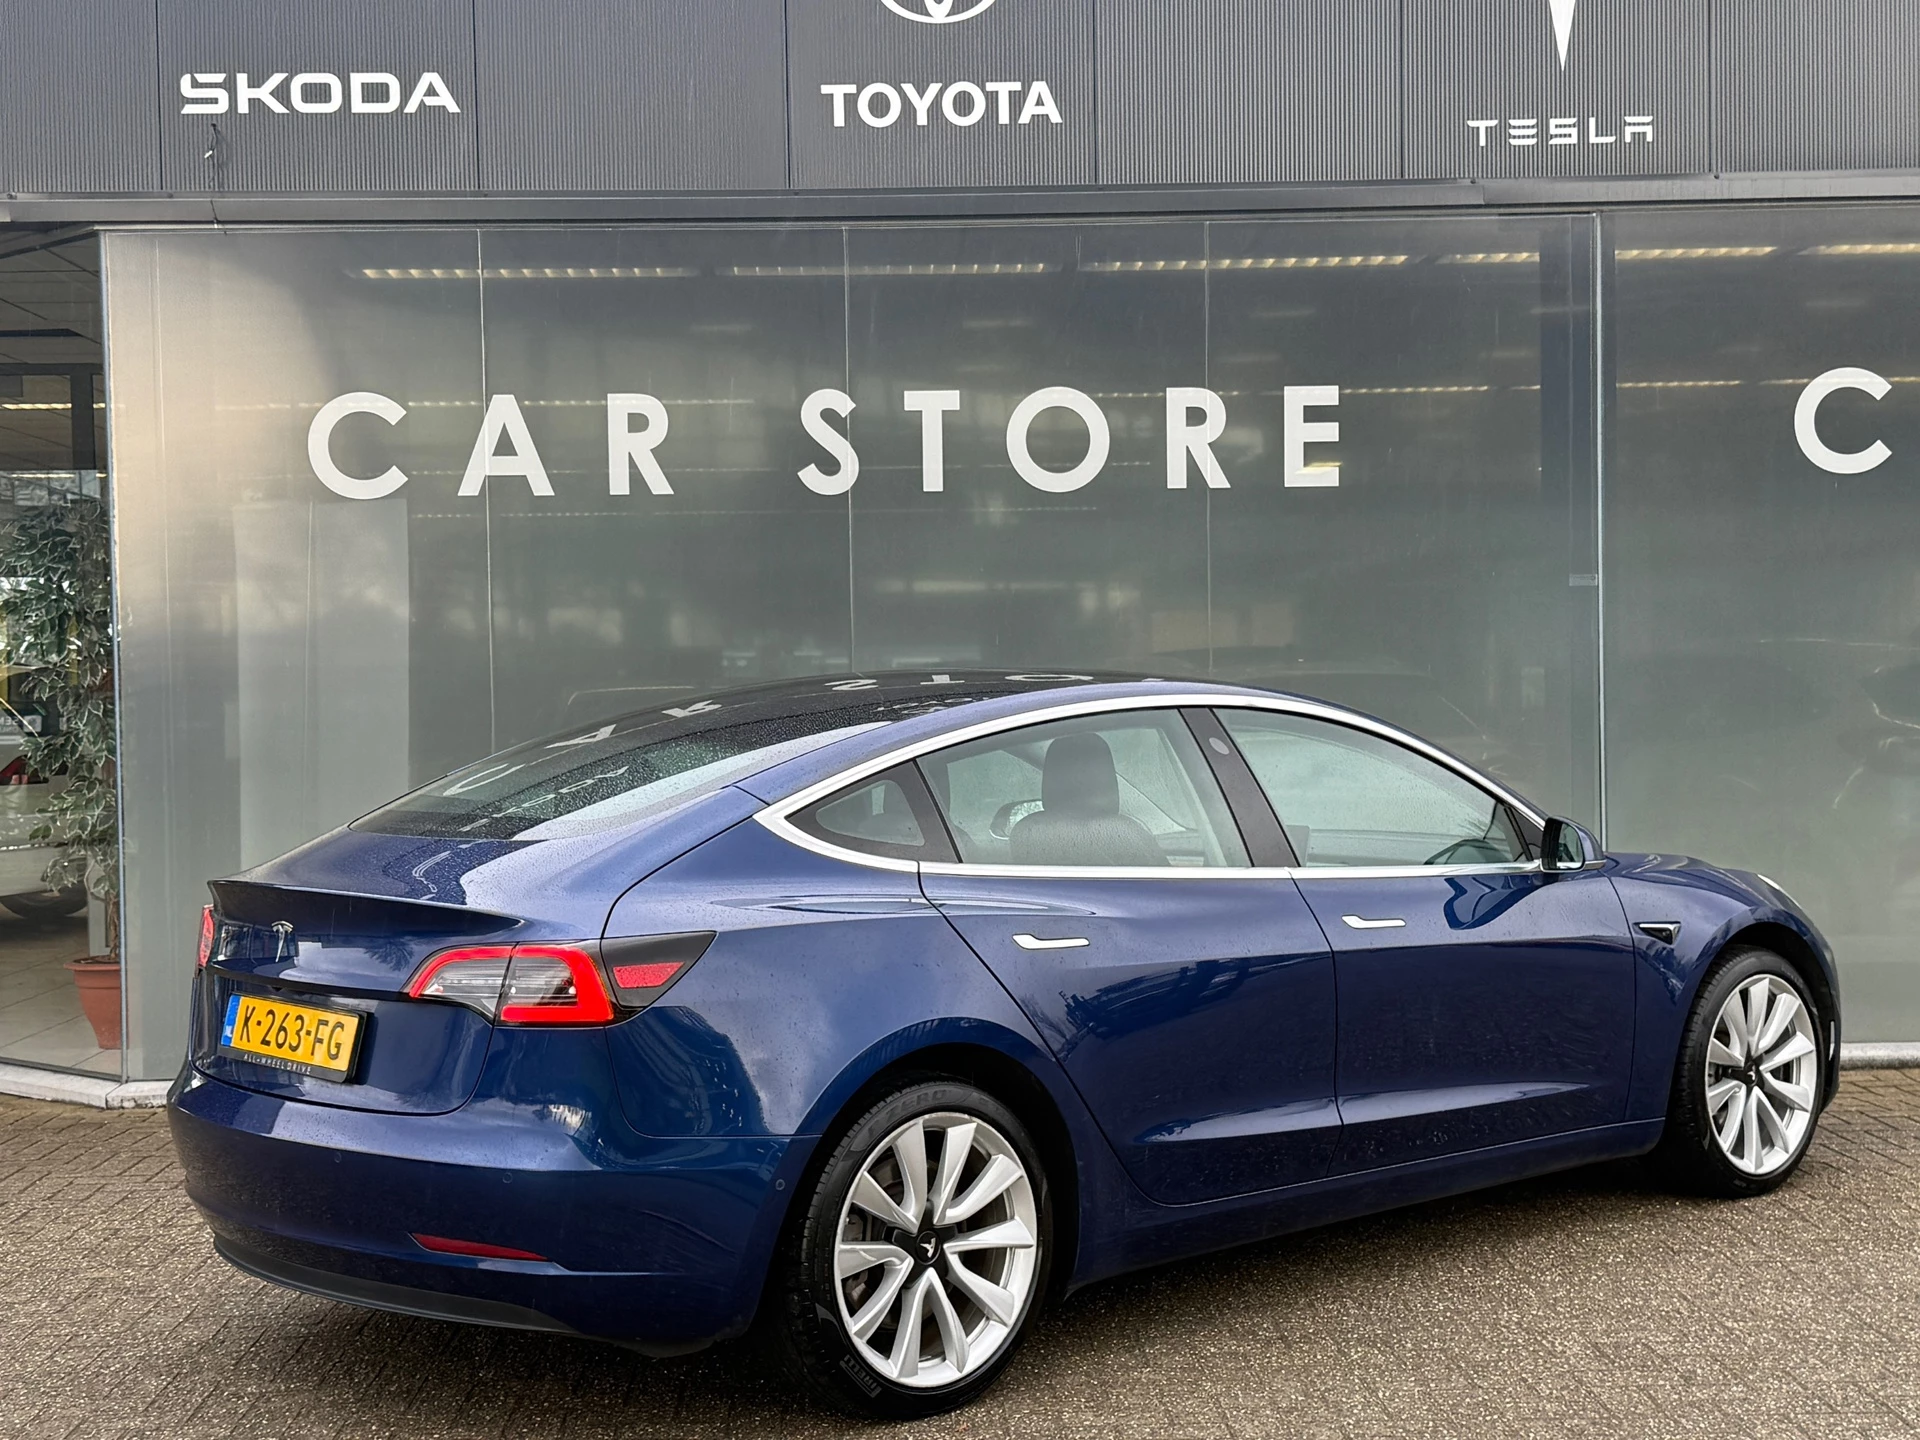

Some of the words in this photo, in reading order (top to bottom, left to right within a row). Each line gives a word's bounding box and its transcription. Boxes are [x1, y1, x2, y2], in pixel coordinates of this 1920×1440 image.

[820, 80, 1063, 128] TOYOTA
[1466, 115, 1654, 147] TESLA
[307, 391, 674, 500] CAR
[797, 385, 1342, 496] STORE
[239, 1004, 346, 1061] K-263-FG
[243, 1053, 285, 1069] ALL-WHEEL
[286, 1062, 312, 1075] DRIVE
